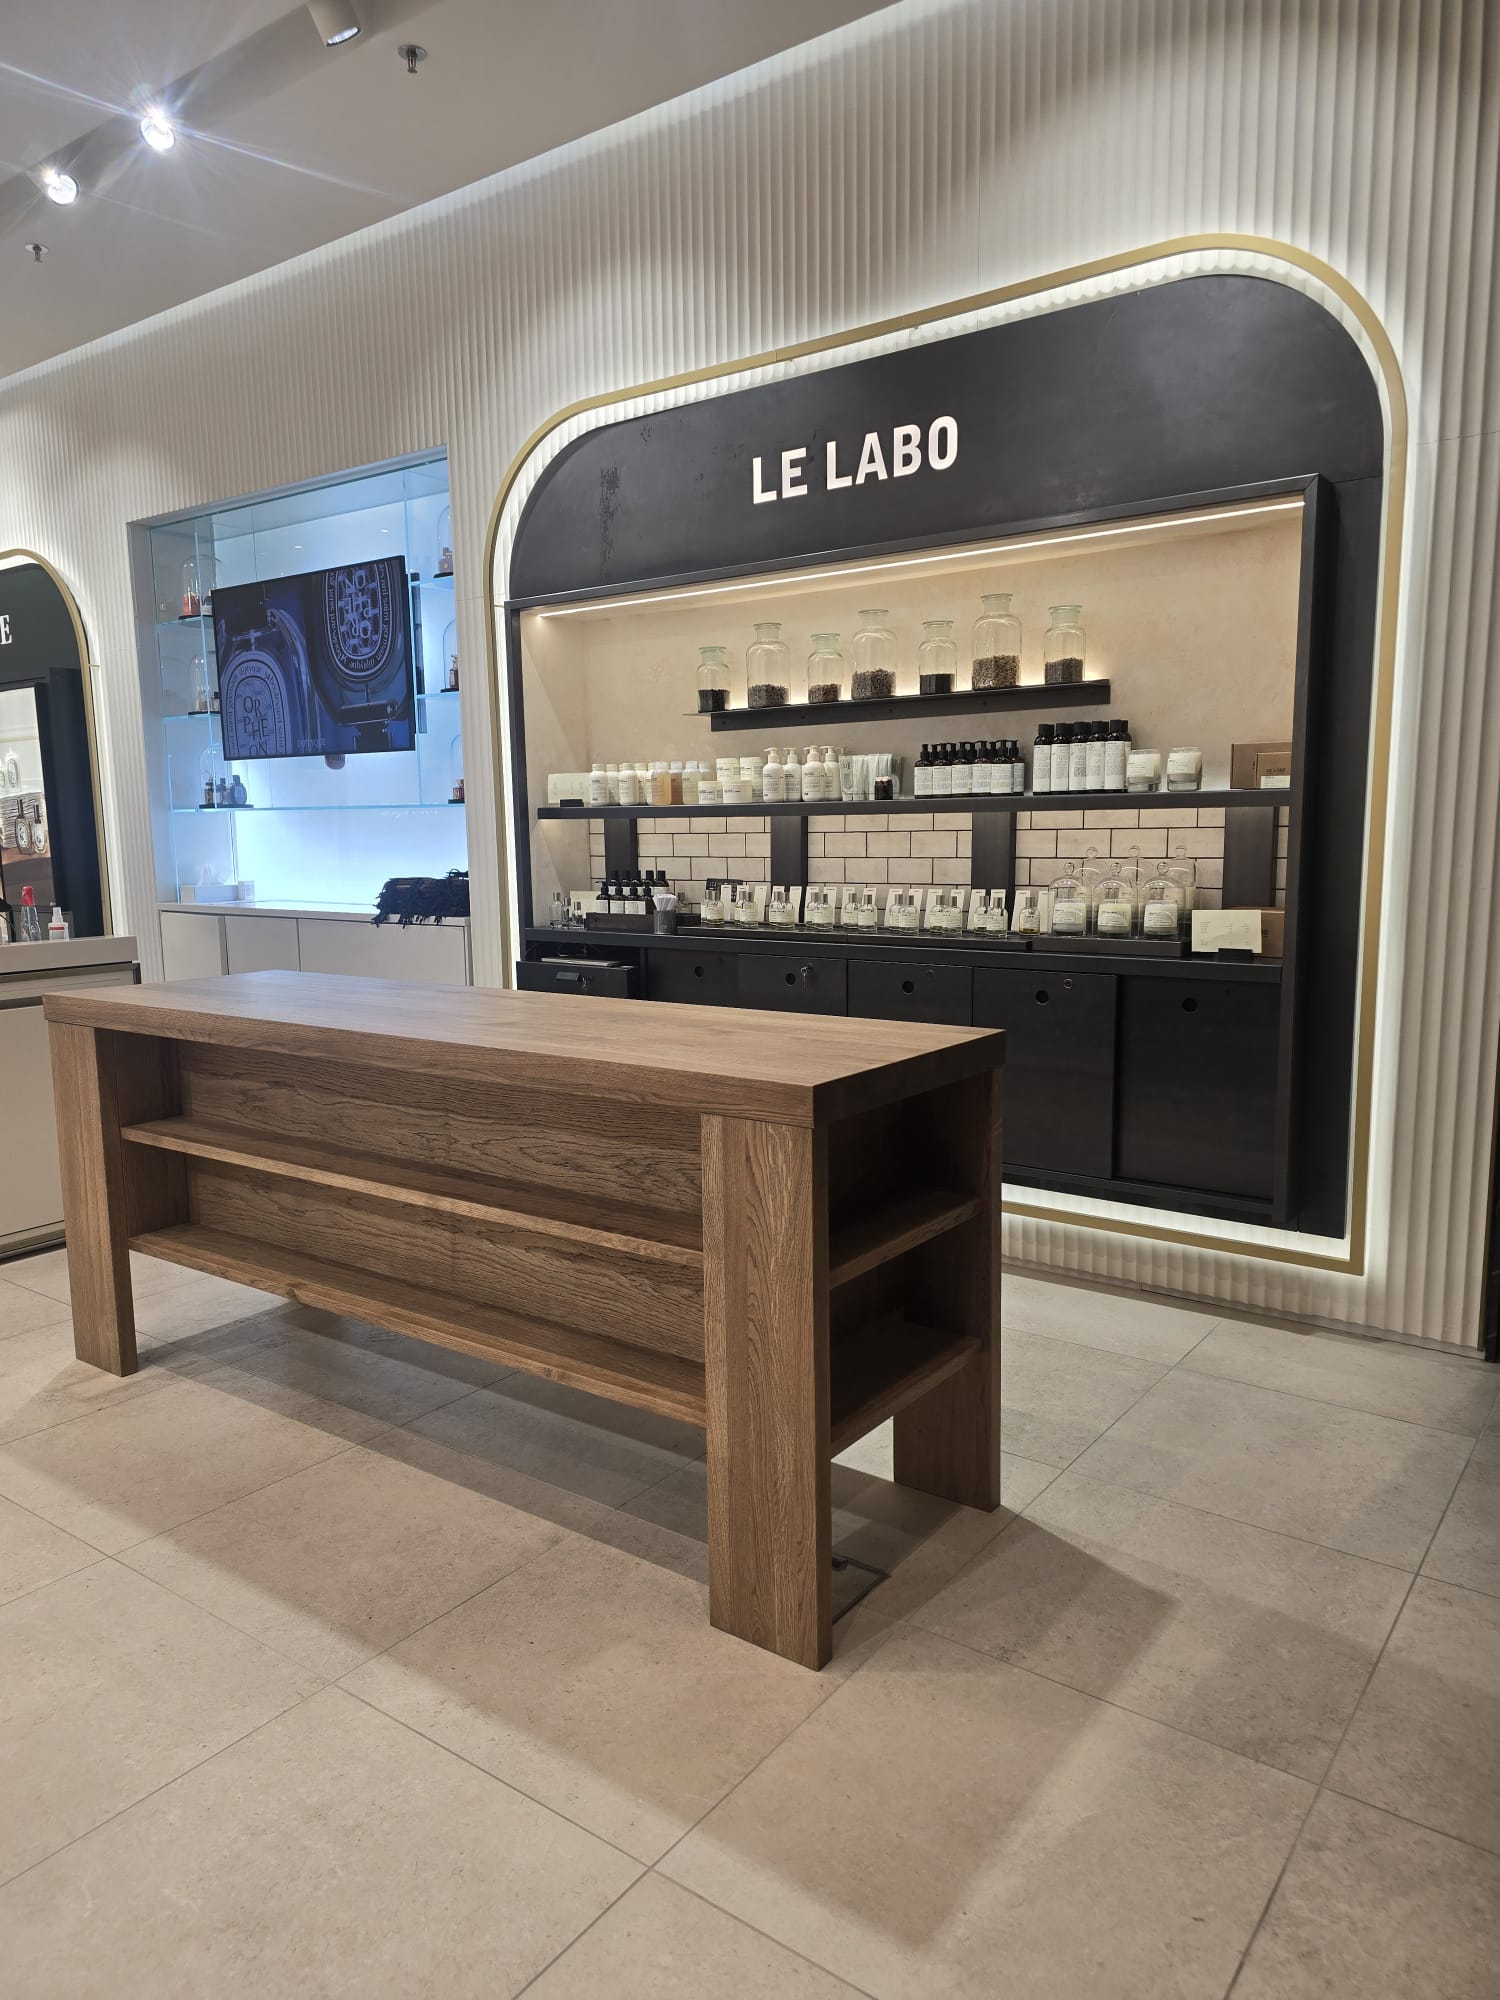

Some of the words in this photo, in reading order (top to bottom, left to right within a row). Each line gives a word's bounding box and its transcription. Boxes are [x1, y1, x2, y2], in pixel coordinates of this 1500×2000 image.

[752, 447, 808, 504] LE
[826, 415, 958, 490] LABO
[350, 618, 371, 638] OR
[243, 695, 263, 717] OR
[243, 716, 268, 740] PHE
[249, 740, 267, 756] ON
